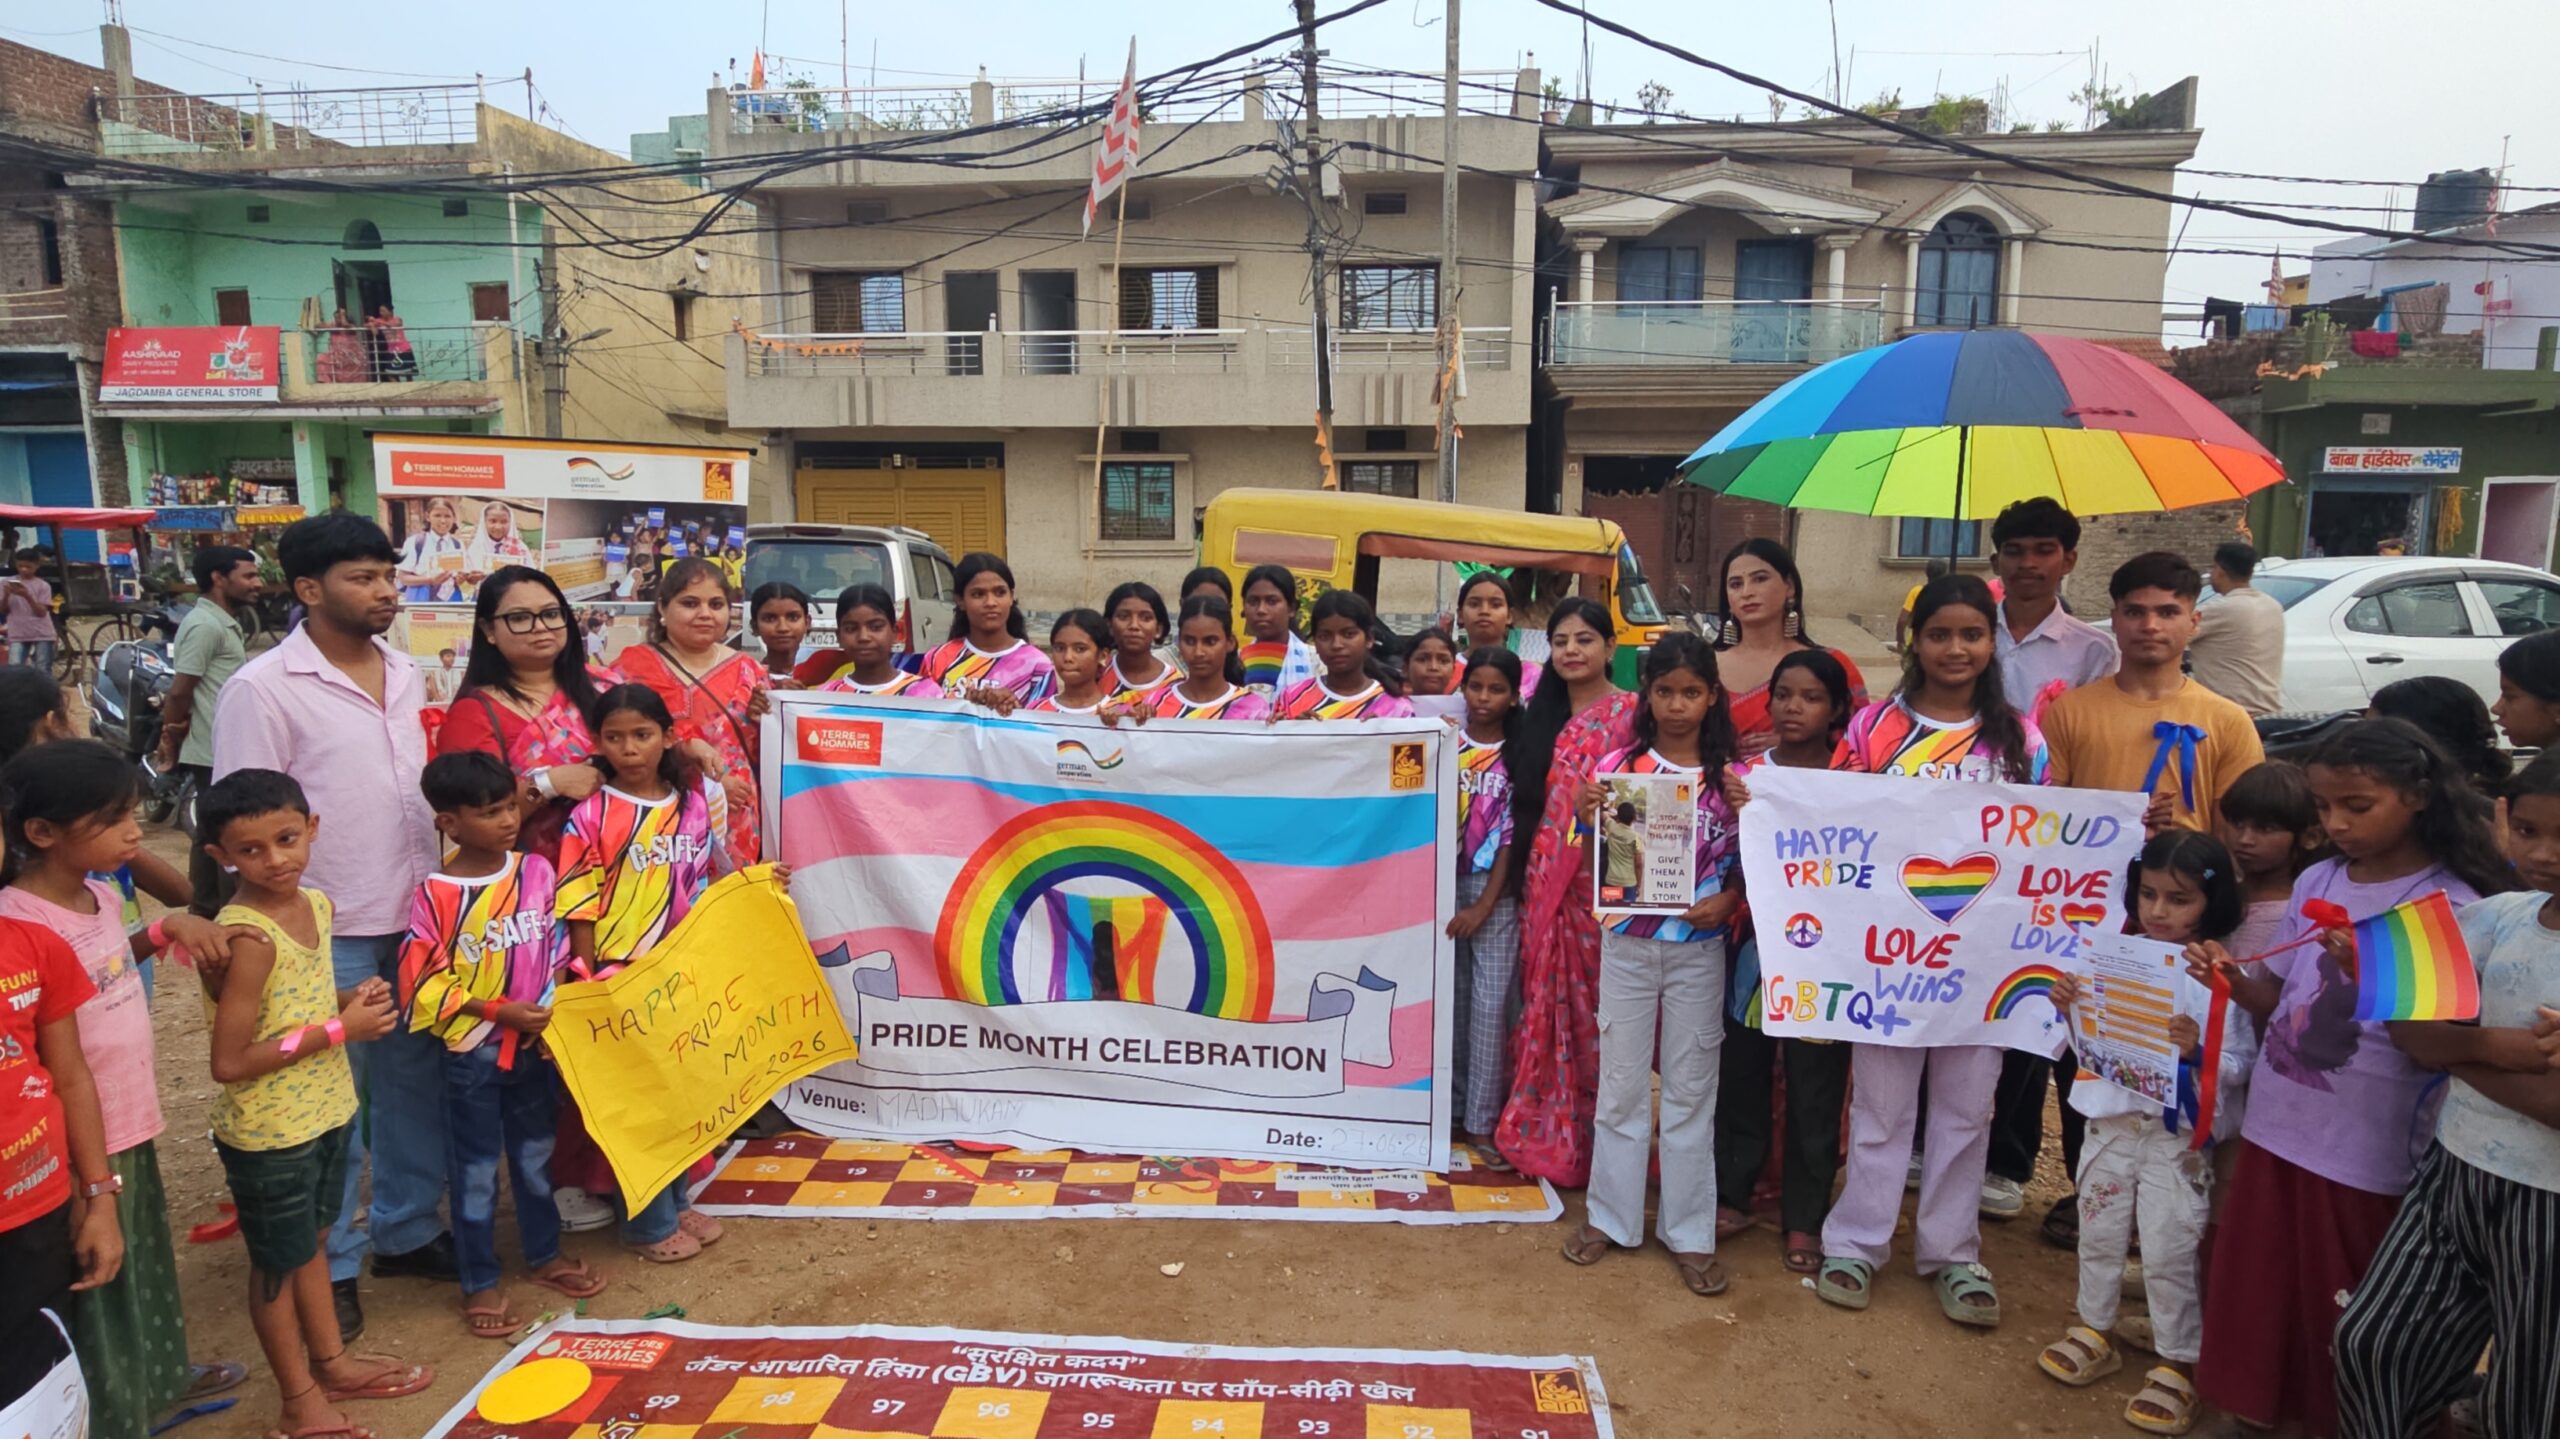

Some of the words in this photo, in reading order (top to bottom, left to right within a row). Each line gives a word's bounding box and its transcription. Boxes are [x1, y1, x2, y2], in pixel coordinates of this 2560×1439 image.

[115, 388, 173, 397] JAGDAMBA
[176, 388, 224, 397] GENERAL
[228, 388, 263, 397] STORE
[2329, 452, 2359, 466] बाबा
[414, 464, 442, 472] TERRE
[454, 465, 494, 474] HOMMES
[821, 730, 856, 739] TERRE
[820, 739, 870, 750] HOMMES
[1980, 804, 2120, 849] PROUD
[1774, 826, 1878, 861] HAPPY
[1658, 856, 1681, 864] GIVE
[1650, 868, 1676, 877] THEM
[1679, 868, 1685, 876] A
[1657, 881, 1678, 889] NEW
[2017, 864, 2113, 899] LOVE
[1652, 893, 1682, 902] STORY
[1865, 923, 1961, 969] LOVE
[2010, 922, 2079, 959] LOVE
[587, 965, 699, 1043] HAPPY
[669, 974, 744, 1063] PRIDE
[724, 991, 820, 1075] MONTH
[871, 1023, 968, 1048] PRIDE
[979, 1026, 1088, 1061] MONTH
[1100, 1037, 1327, 1072] CELEBRATION
[799, 1087, 866, 1114] Venue:
[1, 1116, 48, 1160] WHAT
[1266, 1128, 1323, 1148] Date:
[774, 1141, 795, 1150] 21
[754, 1163, 780, 1173] 20
[847, 1167, 868, 1175] 19
[1016, 1168, 1036, 1178] 17
[1141, 1167, 1161, 1176] 15
[4, 1155, 59, 1200] THING
[745, 1188, 753, 1197] 1
[834, 1190, 846, 1198] 2
[922, 1189, 937, 1199] 3
[1251, 1190, 1264, 1200] 7
[1407, 1192, 1420, 1203] 9
[1487, 1193, 1510, 1203] 10
[571, 1337, 635, 1351] TERRE
[639, 1339, 664, 1350] DES
[557, 1349, 658, 1364] HOMMES
[750, 1353, 863, 1375] आधारित
[931, 1364, 1028, 1388] (GBV)
[1181, 1380, 1217, 1398] पर
[1360, 1380, 1416, 1402] खेल
[644, 1394, 680, 1409] 99
[760, 1391, 795, 1408] 98
[871, 1398, 905, 1416] 97
[977, 1402, 1011, 1418] 96
[1082, 1412, 1115, 1429] 95
[1191, 1419, 1225, 1433] 94
[1298, 1419, 1330, 1435] 93
[1403, 1424, 1435, 1439] 92
